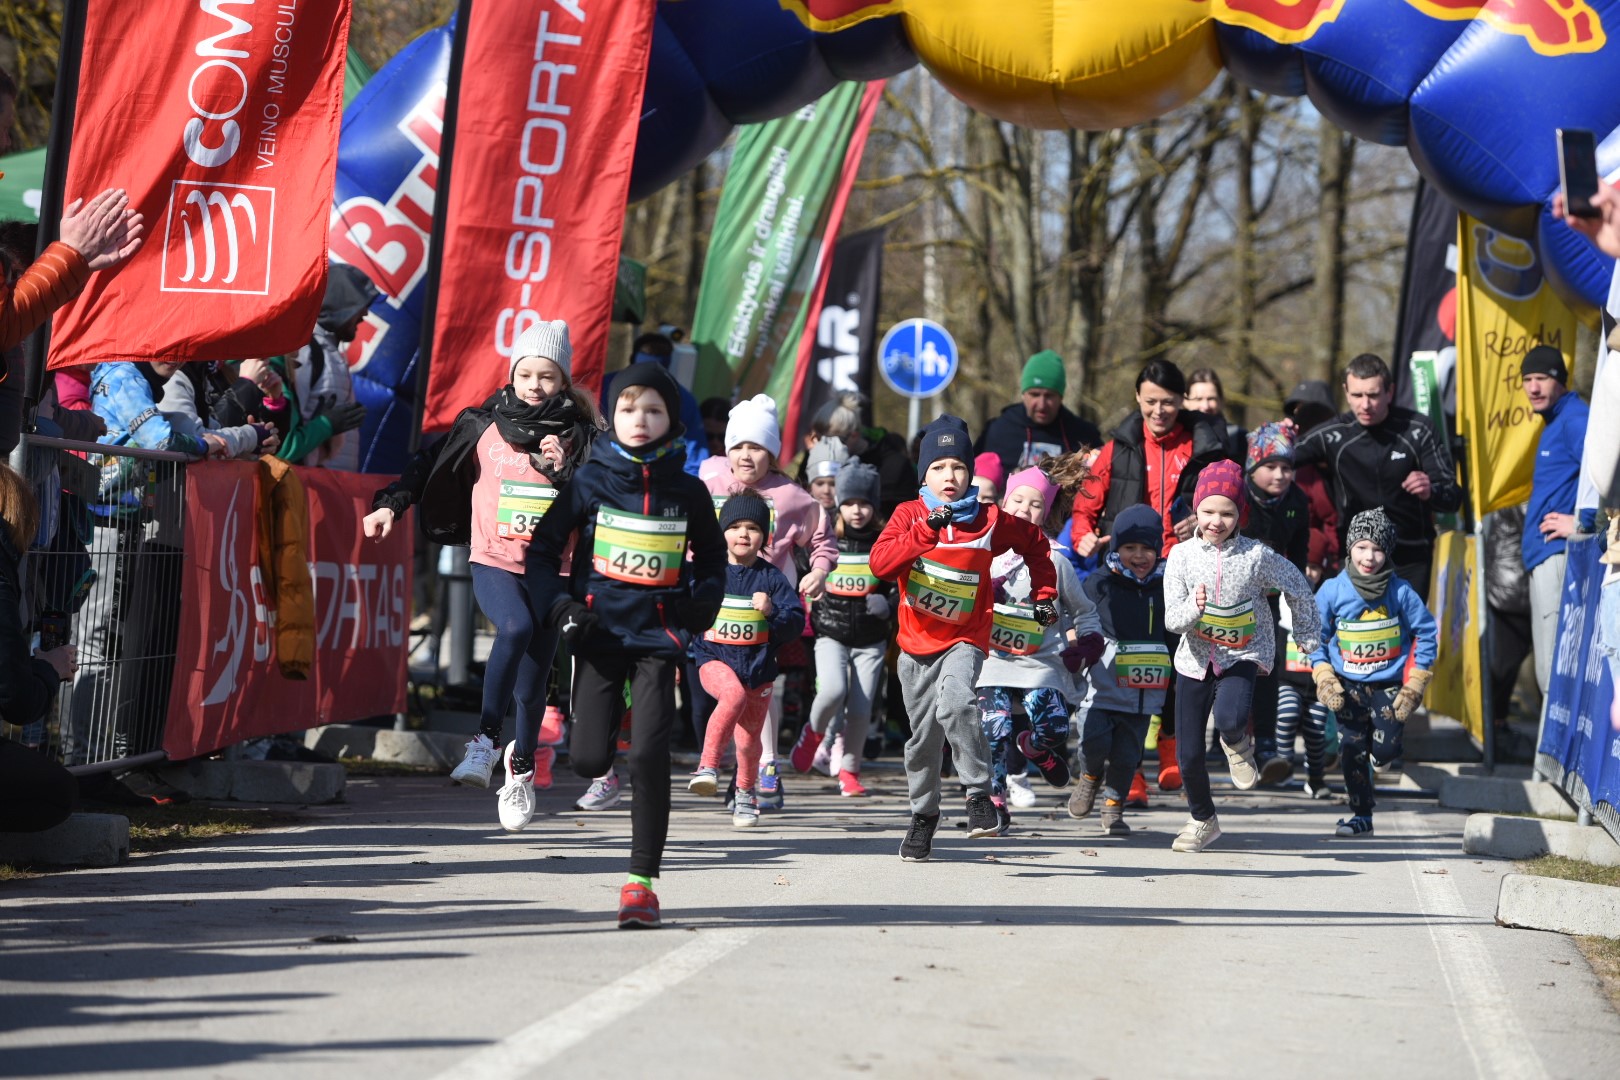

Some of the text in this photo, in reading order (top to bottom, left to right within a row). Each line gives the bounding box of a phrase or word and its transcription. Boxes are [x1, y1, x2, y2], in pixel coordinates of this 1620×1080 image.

[256, 102, 281, 170] VEINO
[331, 96, 447, 300] Bul
[746, 243, 767, 264] ir
[1485, 323, 1562, 361] Ready
[1503, 363, 1524, 393] fo
[1487, 405, 1536, 431] mov
[513, 513, 541, 535] 35
[658, 523, 677, 531] 2022
[612, 551, 662, 578] 429
[835, 577, 866, 591] 499
[959, 574, 973, 582] 2022
[919, 591, 960, 618] 427
[1234, 605, 1246, 614] 2022
[718, 622, 754, 640] 498
[1378, 620, 1392, 628] 2022
[991, 628, 1026, 650] 426
[1201, 626, 1240, 644] 423
[1353, 642, 1387, 659] 425
[1131, 667, 1163, 684] 357
